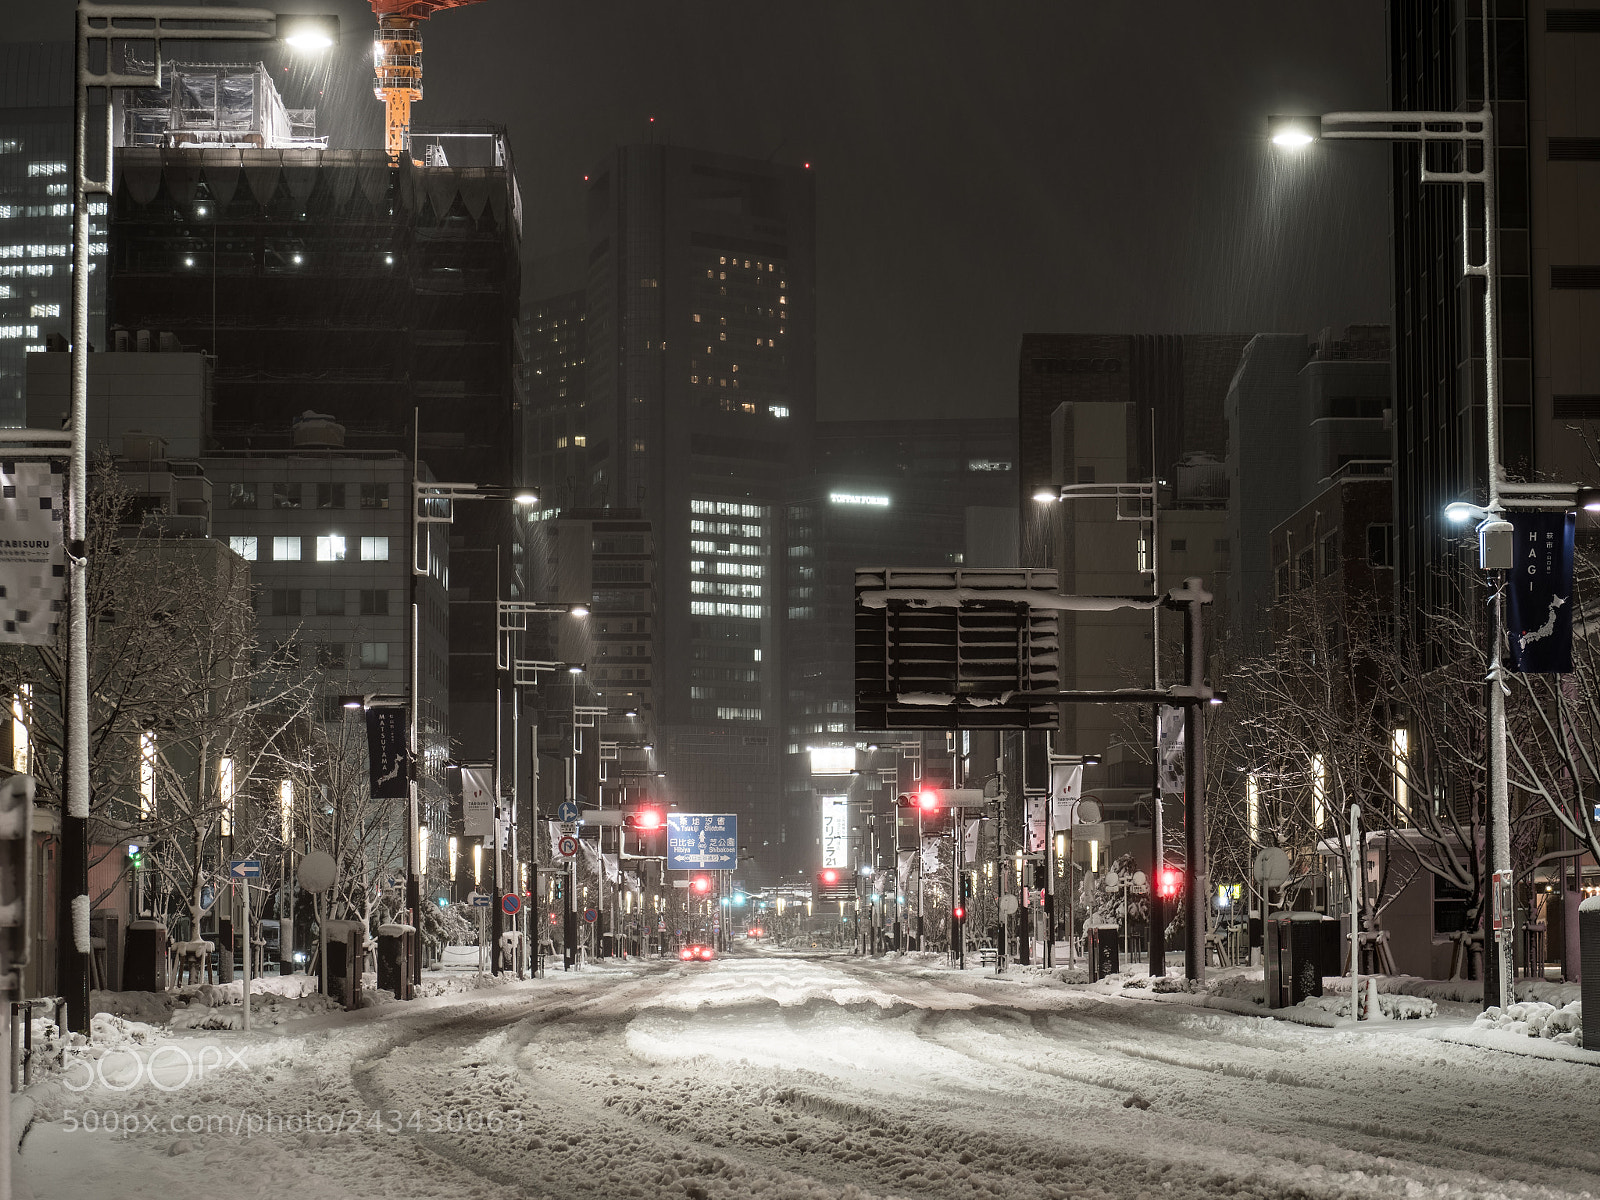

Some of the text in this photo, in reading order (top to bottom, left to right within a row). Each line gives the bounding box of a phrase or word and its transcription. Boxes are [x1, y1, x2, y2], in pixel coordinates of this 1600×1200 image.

[1528, 532, 1537, 591] HAGI
[379, 714, 388, 770] MATSUYAMA
[670, 838, 695, 846] 日比谷
